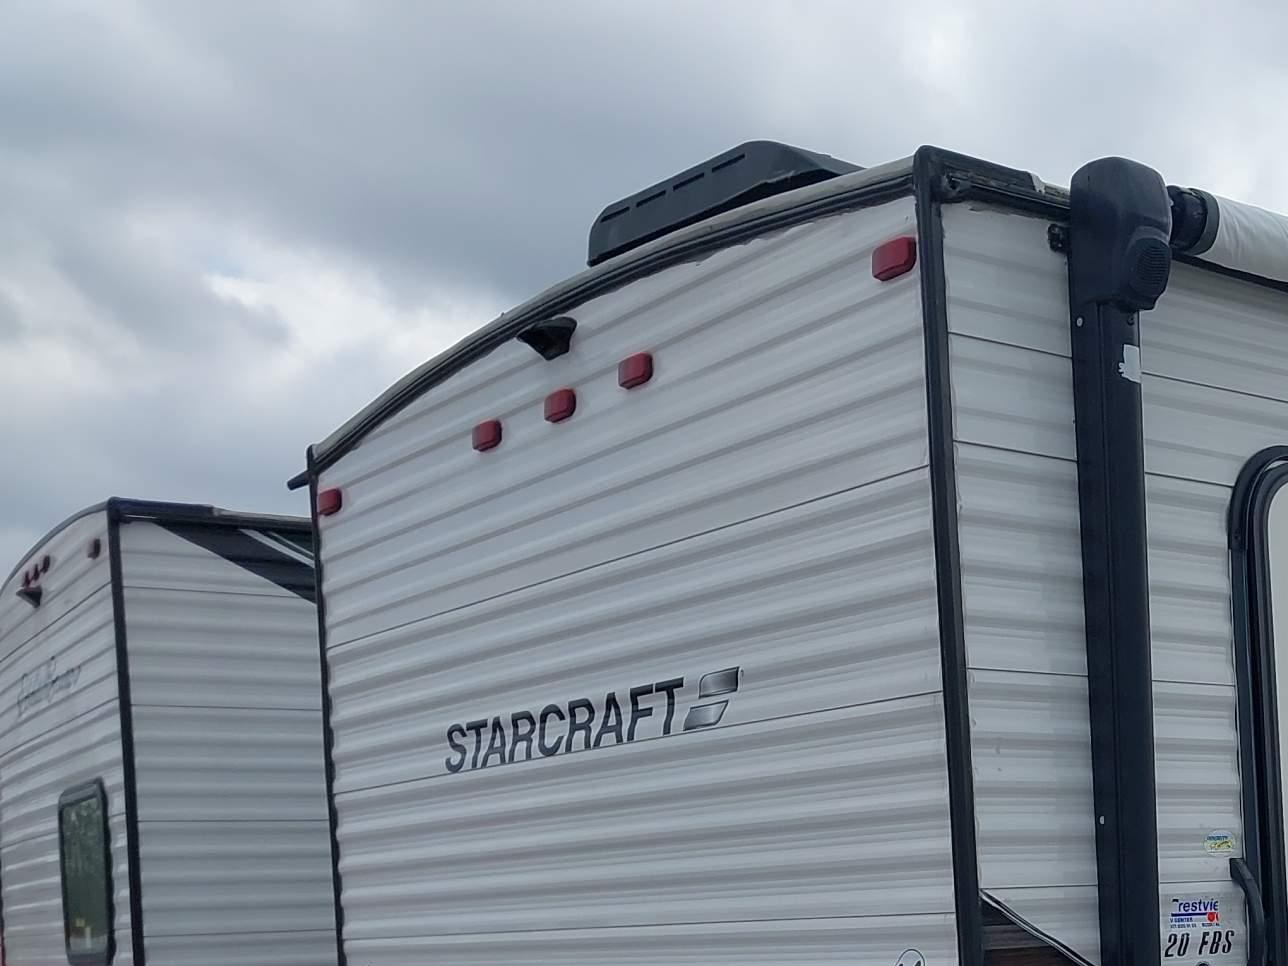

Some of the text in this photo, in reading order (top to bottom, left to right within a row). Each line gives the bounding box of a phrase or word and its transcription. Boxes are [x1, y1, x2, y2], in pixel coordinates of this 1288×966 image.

[445, 676, 685, 773] STARCRAFT
[1164, 930, 1235, 957] 20 FBS
